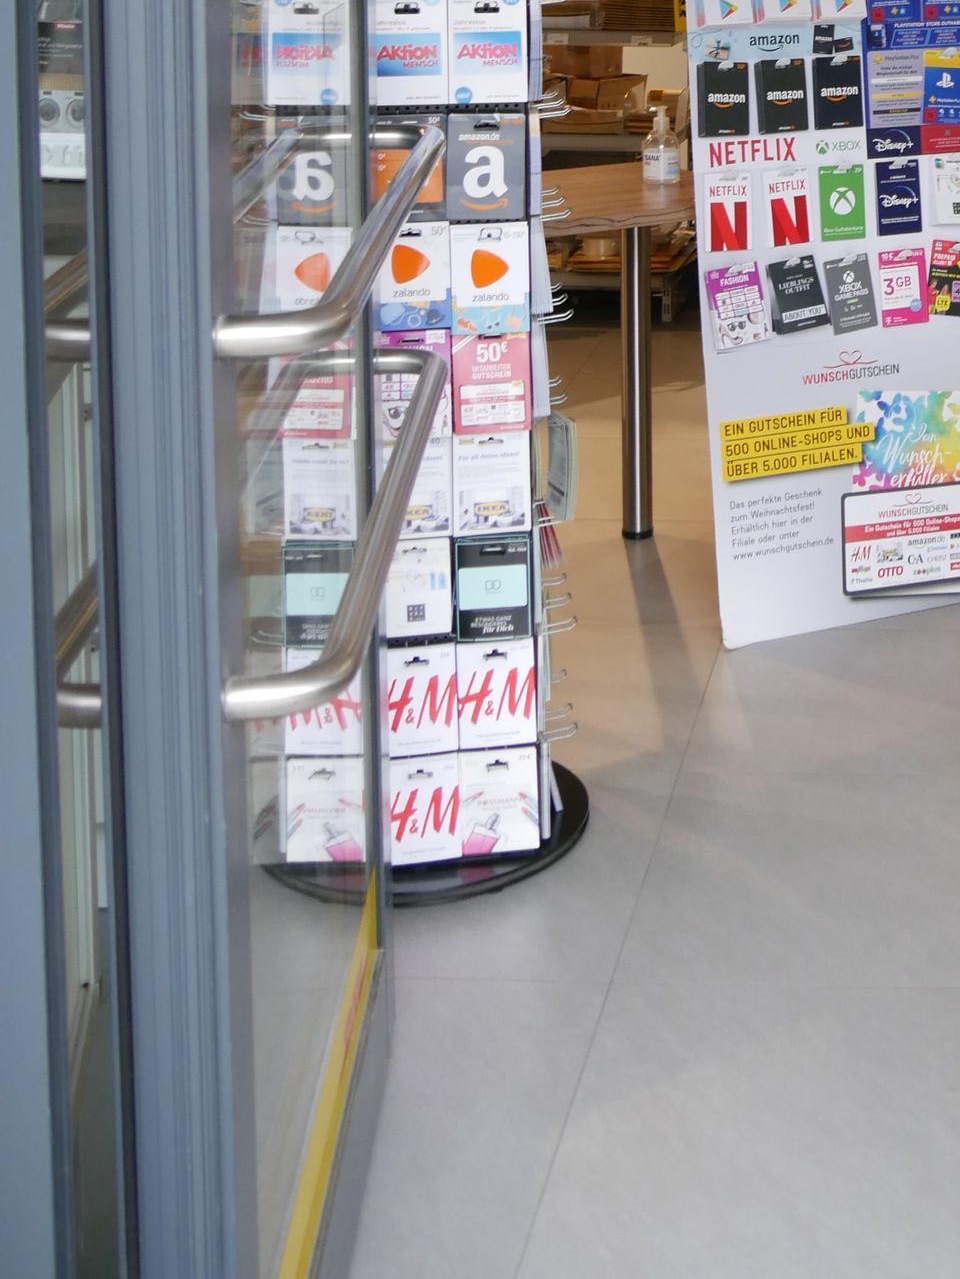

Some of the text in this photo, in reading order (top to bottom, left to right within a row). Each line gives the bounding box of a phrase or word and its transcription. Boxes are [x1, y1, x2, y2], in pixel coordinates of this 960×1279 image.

[750, 34, 800, 46] amazon
[402, 59, 438, 68] MENSCH
[483, 58, 518, 66] MENSCH
[708, 93, 746, 104] amazon
[766, 90, 804, 100] amazon
[820, 86, 858, 97] amazon
[458, 132, 500, 141] amazon.de
[709, 137, 796, 168] NETFLIX
[832, 140, 861, 152] XBOX
[710, 185, 747, 197] NETFLIX
[768, 179, 806, 194] NETFLIX
[720, 274, 749, 286] FASHION
[778, 276, 814, 290] LIEBLINGS
[883, 276, 912, 296] 3 GB
[393, 288, 430, 298] zalando
[838, 281, 862, 294] XBOX
[472, 293, 510, 302] zalando
[834, 289, 869, 301] GAME PASS
[784, 310, 806, 320] ABOUT
[476, 340, 508, 363] 50€
[472, 371, 512, 381] GUTSCHEIN
[803, 364, 900, 385] WUNSCHGUTSCHEIN
[724, 408, 842, 436] EIN GUTSCHEIN FÜR
[726, 426, 870, 457] 500 ONLINE-SHOPS UND
[727, 448, 858, 478] ÜBER 5.000 FILIALEN.
[730, 488, 822, 510] Das perfekte Geschenk
[730, 501, 816, 522] zum Weihnachtsfest!
[878, 504, 949, 519] WUNSCHGUTSCHEIN
[732, 515, 814, 536] Erhältlich hier in der
[864, 525, 874, 533] Ein
[875, 522, 902, 532] Gutschein
[903, 520, 912, 528] für
[926, 516, 960, 526] Online-Shops
[732, 530, 800, 548] Filiale oder unter
[908, 535, 946, 546] amazon.de
[733, 536, 834, 560] www.wunschgutschein.de
[878, 566, 904, 578] OTTO
[459, 666, 536, 725] H&M
[388, 674, 457, 732] H&M
[391, 785, 460, 842] H&M
